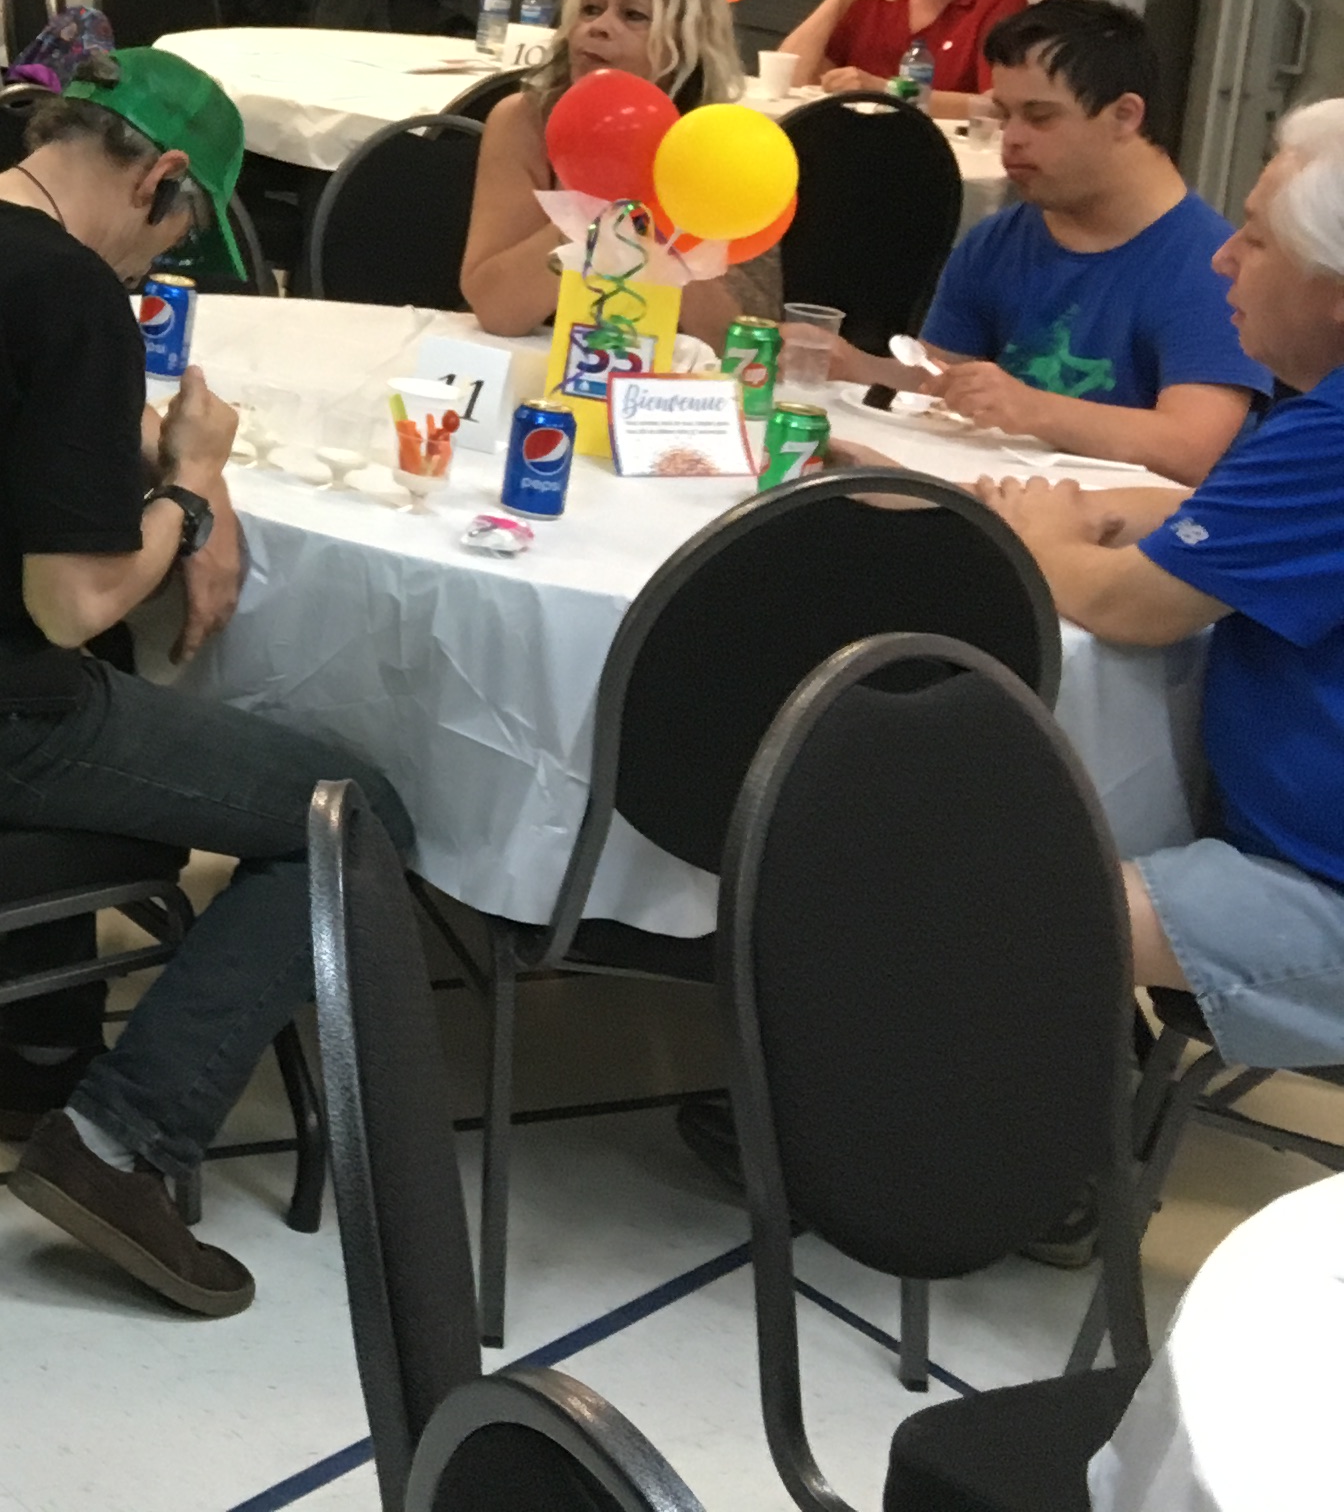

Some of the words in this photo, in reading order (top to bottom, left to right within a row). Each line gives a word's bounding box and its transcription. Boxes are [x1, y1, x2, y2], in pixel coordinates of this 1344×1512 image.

[510, 42, 548, 68] 10
[437, 373, 485, 423] 1
[621, 383, 726, 419] Bienvenue
